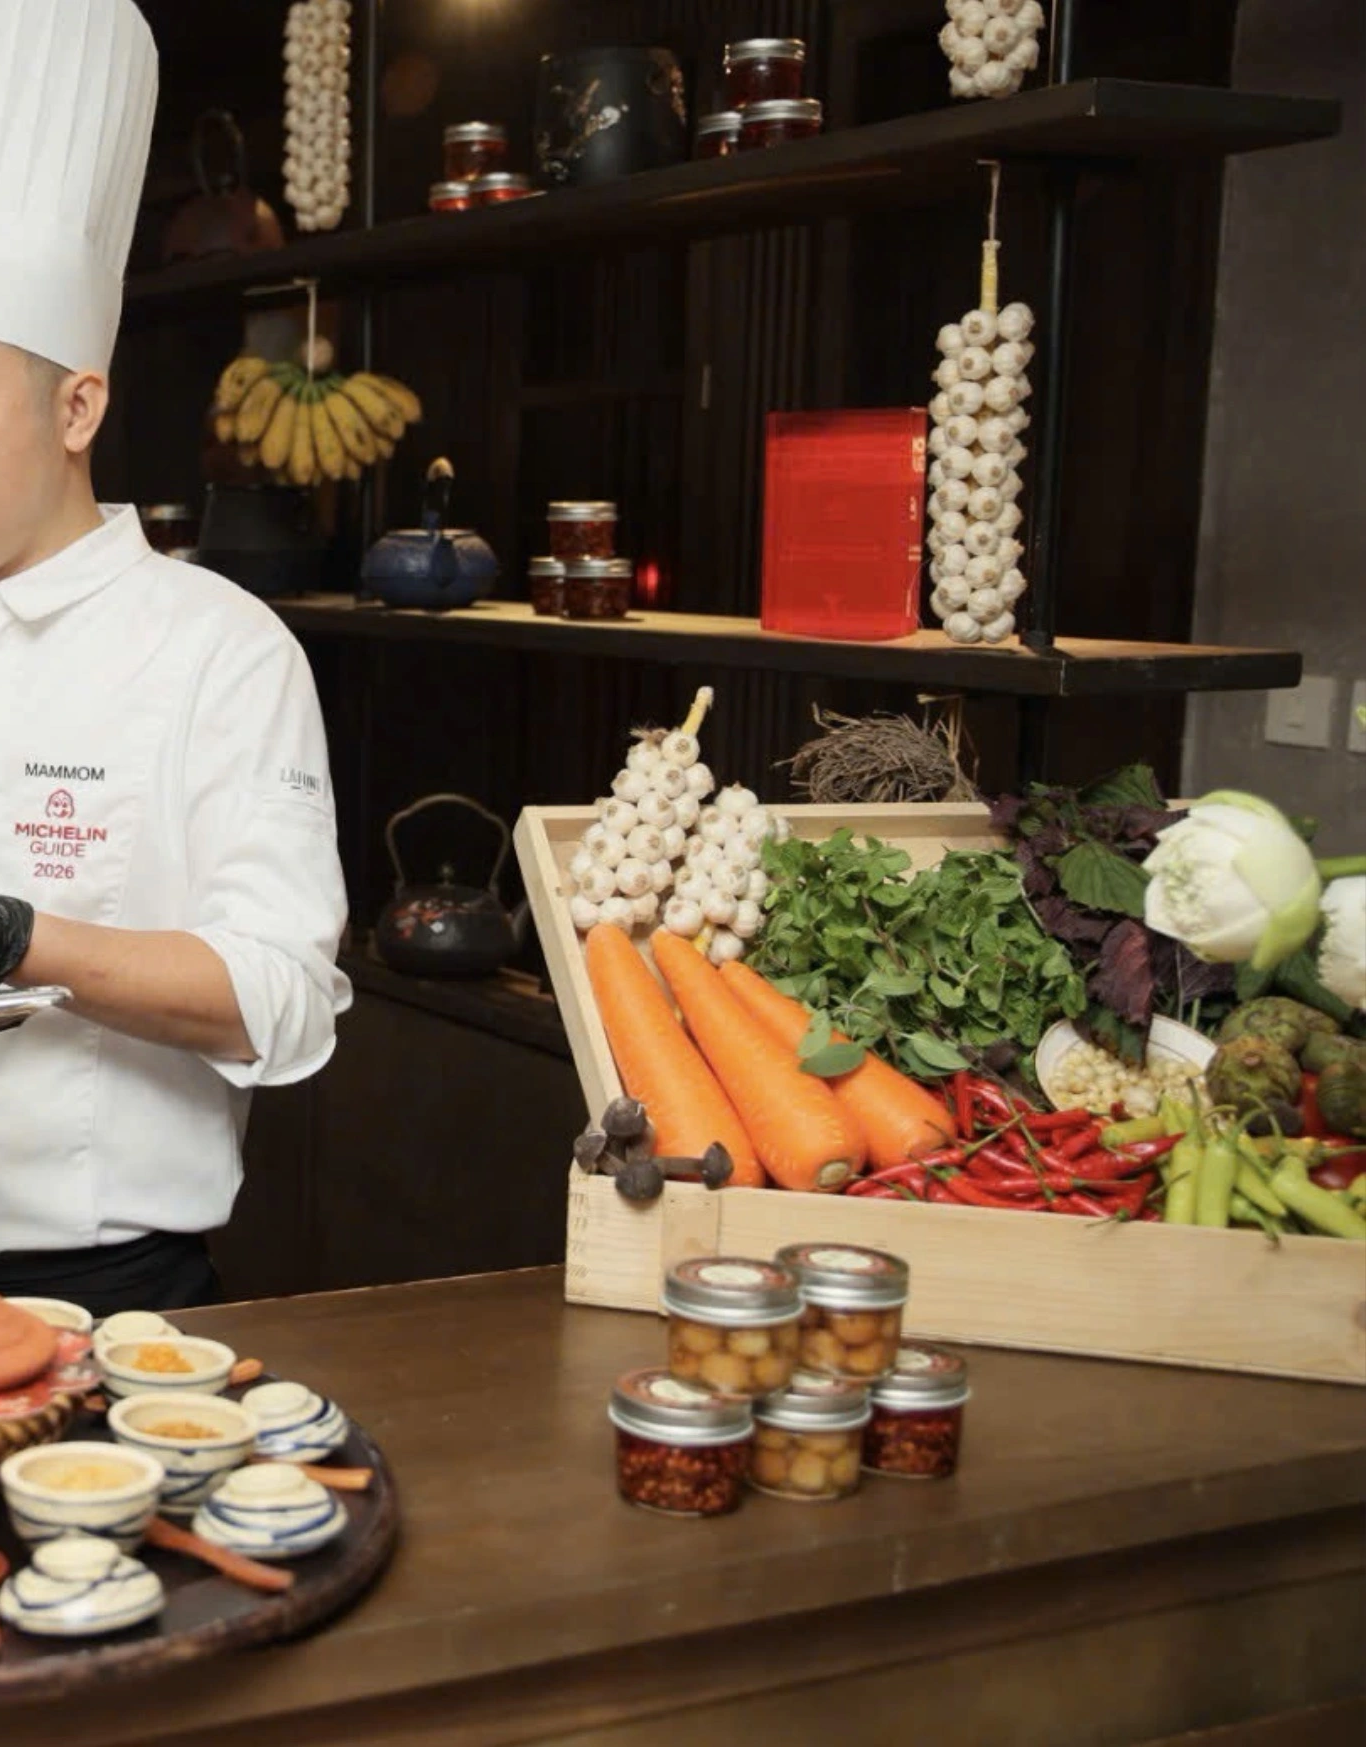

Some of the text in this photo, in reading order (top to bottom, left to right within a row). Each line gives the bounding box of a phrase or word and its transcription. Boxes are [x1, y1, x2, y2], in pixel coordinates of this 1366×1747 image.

[25, 763, 105, 781] MAMMOM
[14, 823, 107, 841] MICHELIN
[30, 841, 86, 858] GUIDE
[34, 862, 74, 879] 2026
